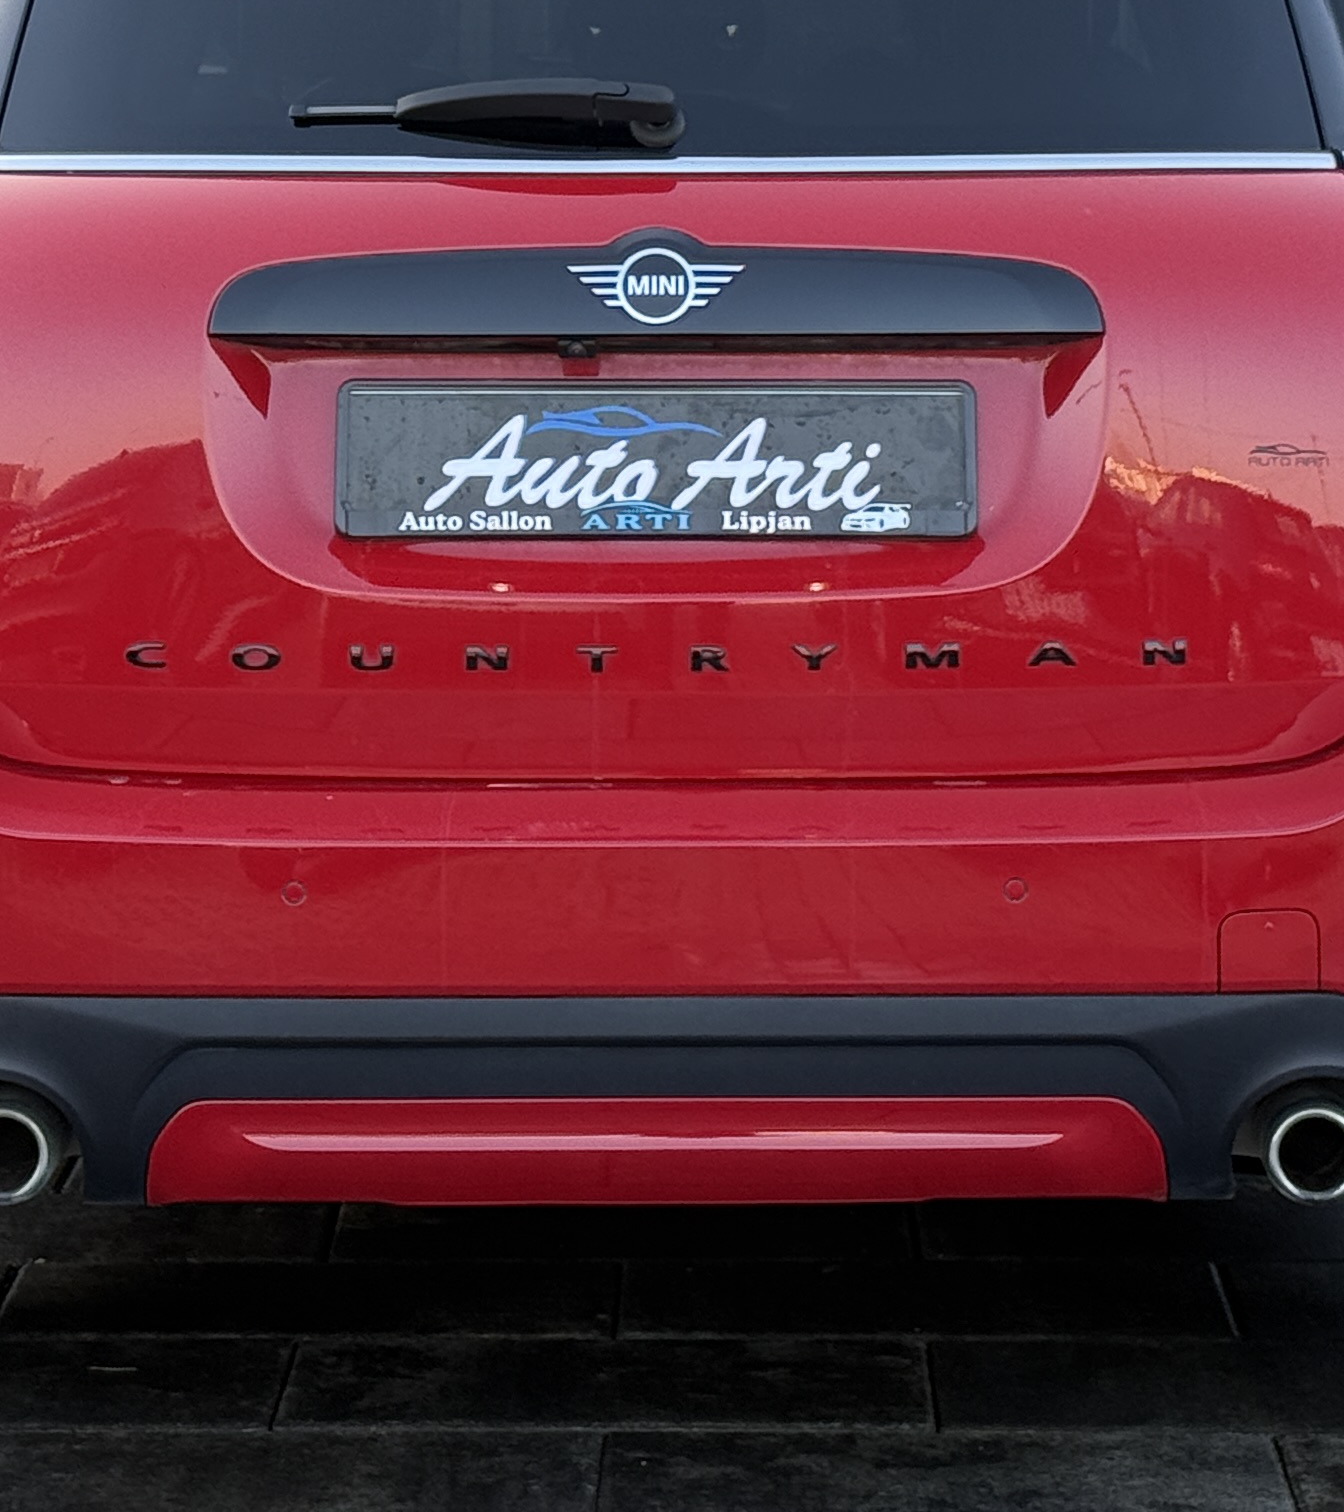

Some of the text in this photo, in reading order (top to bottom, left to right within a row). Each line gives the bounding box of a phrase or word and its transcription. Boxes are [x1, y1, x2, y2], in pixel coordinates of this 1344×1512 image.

[627, 274, 685, 296] MINI
[423, 414, 883, 511] Auto Arti
[1248, 456, 1291, 467] AUTO
[399, 510, 812, 534] Auto Sallon ARTI Lipjan
[124, 639, 1189, 673] COUNTRYMAN
